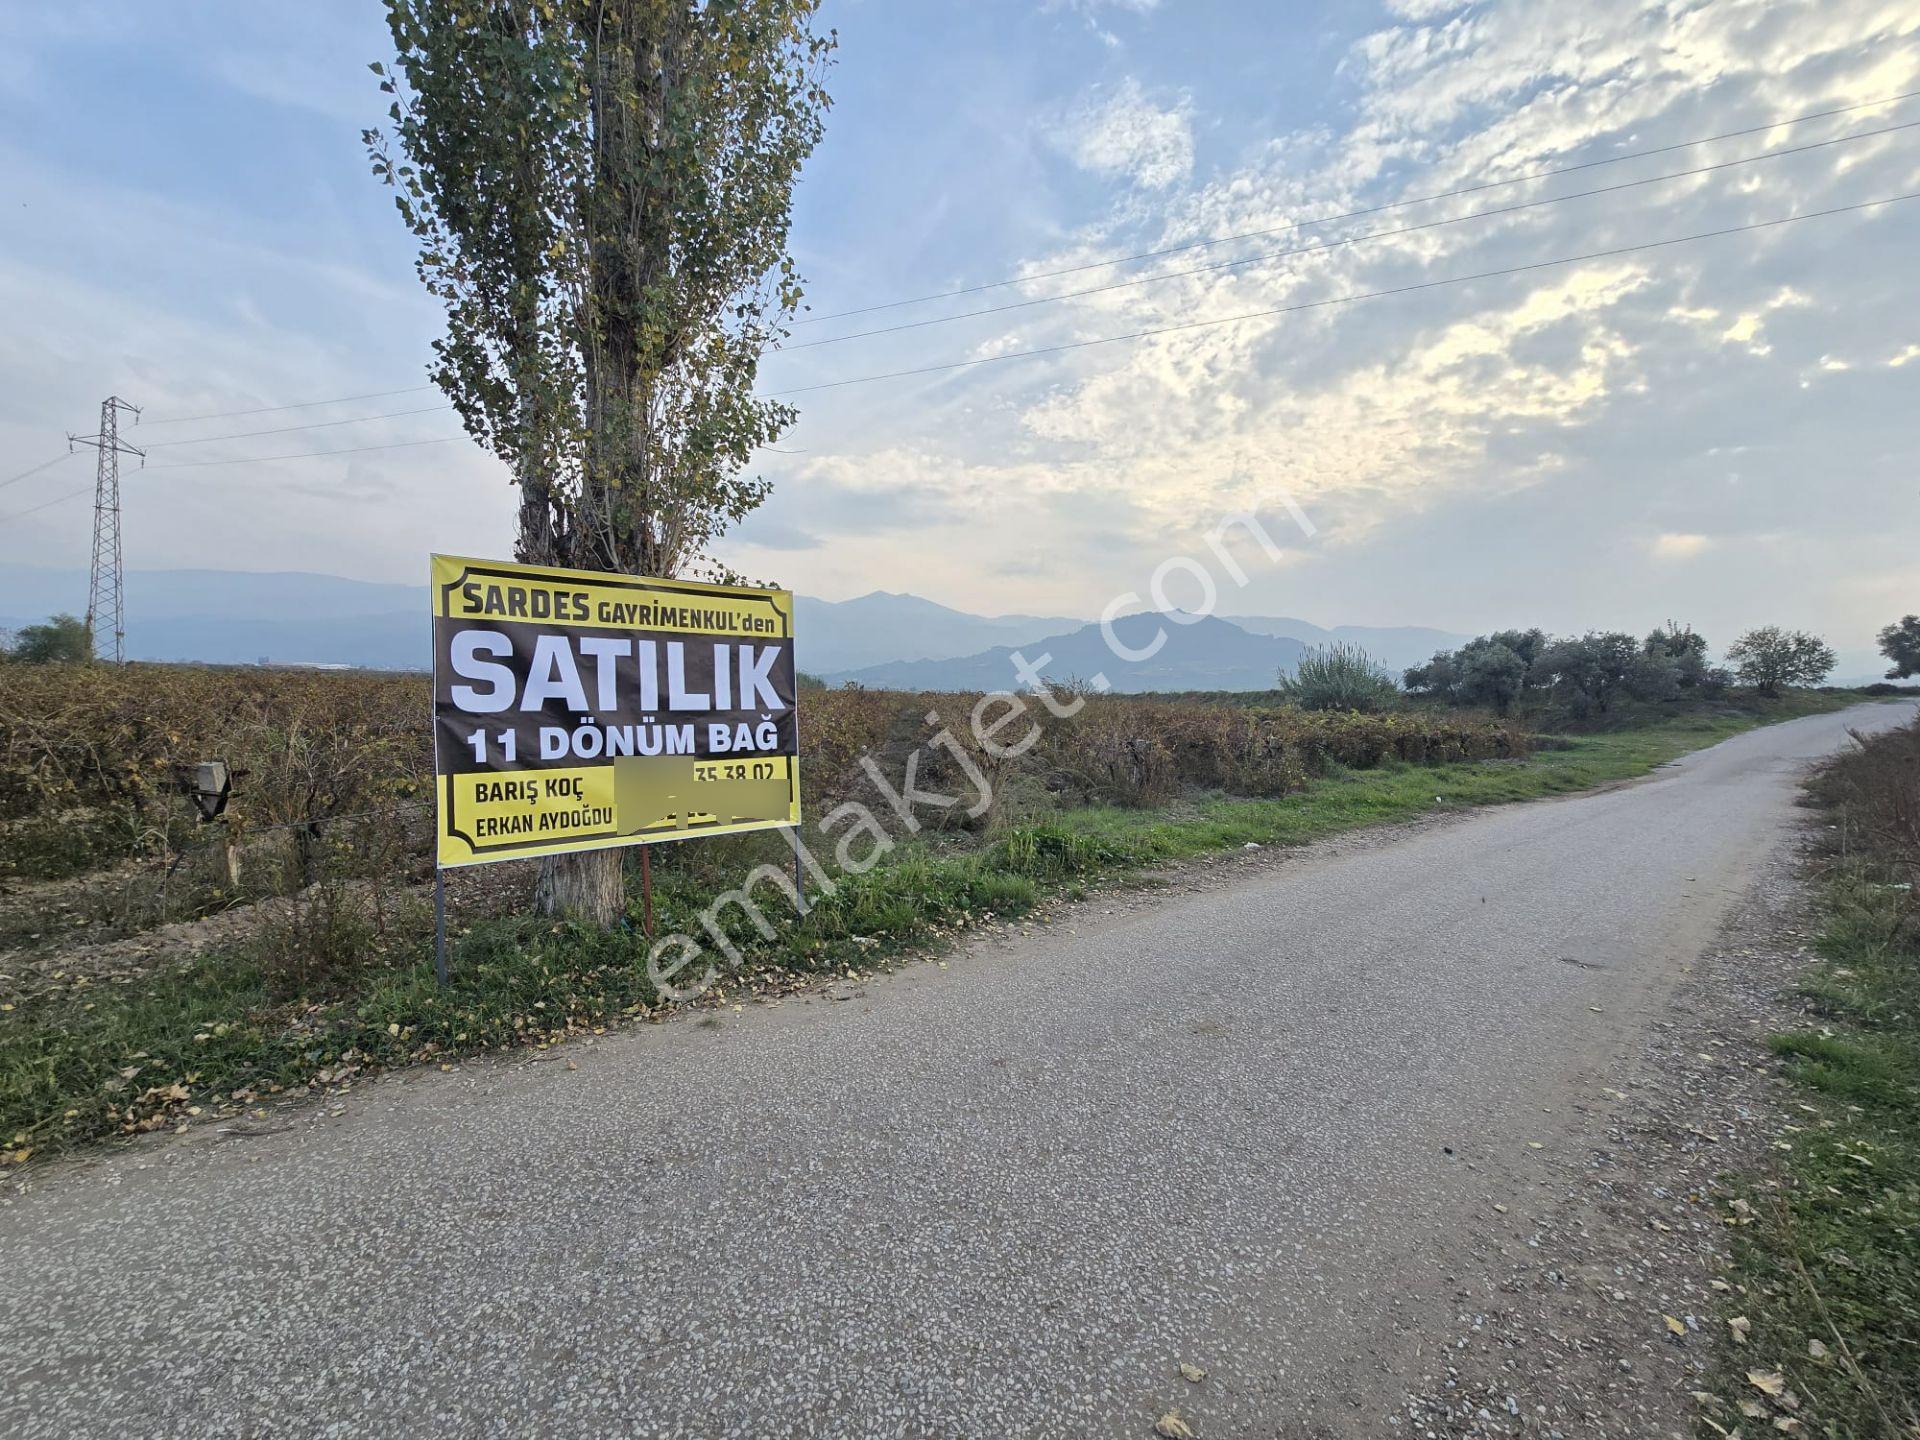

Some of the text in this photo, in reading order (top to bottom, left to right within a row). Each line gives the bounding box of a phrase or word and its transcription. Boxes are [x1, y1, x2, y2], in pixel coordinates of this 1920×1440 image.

[462, 583, 591, 621] SARDES
[450, 629, 786, 713] SATILIK
[467, 713, 778, 763] 11 DÖNÜM BAĞ
[475, 777, 584, 805] BARIŞ KOÇ
[476, 804, 613, 838] ERKAN AYDOĞDU
